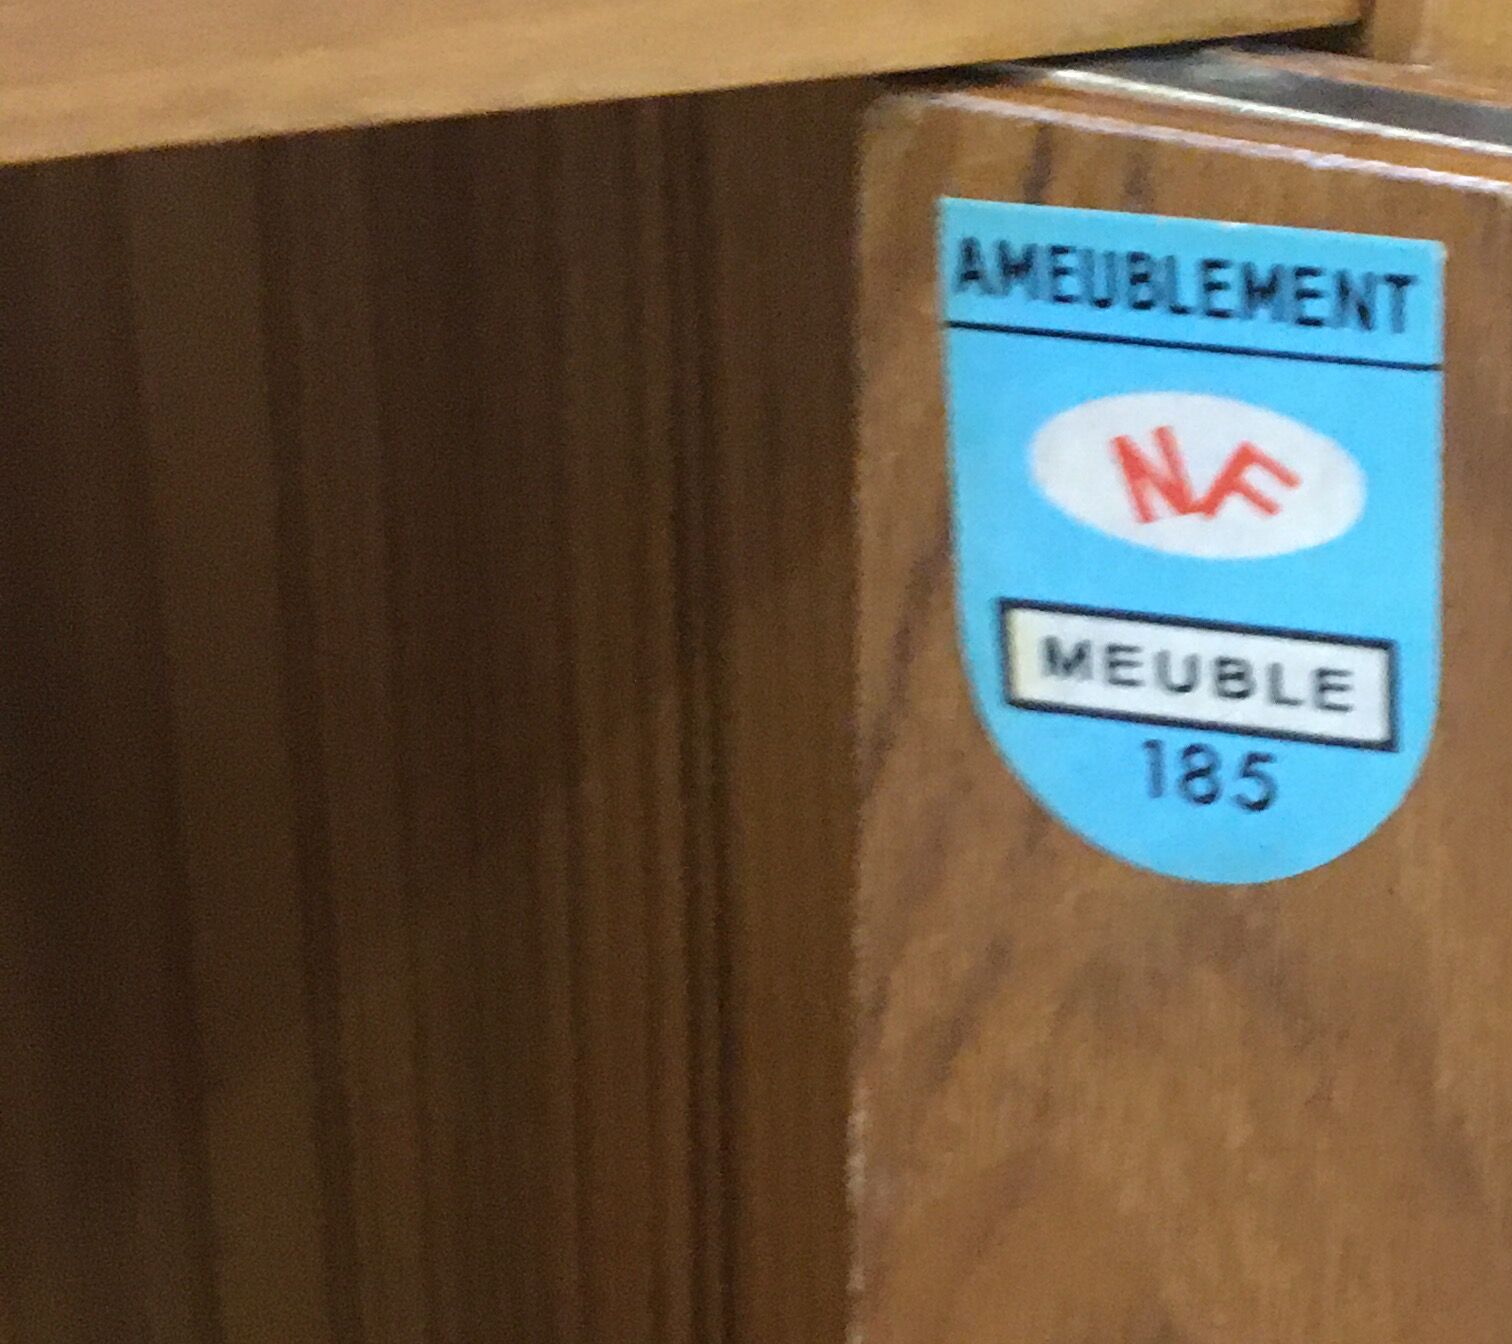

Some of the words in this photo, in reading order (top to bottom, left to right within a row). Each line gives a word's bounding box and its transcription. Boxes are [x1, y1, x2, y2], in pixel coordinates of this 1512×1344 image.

[953, 235, 1420, 335] AMEUBLEMENT
[1111, 425, 1304, 525] NF
[1039, 635, 1356, 713] MEUBLE
[1141, 738, 1279, 814] 185
